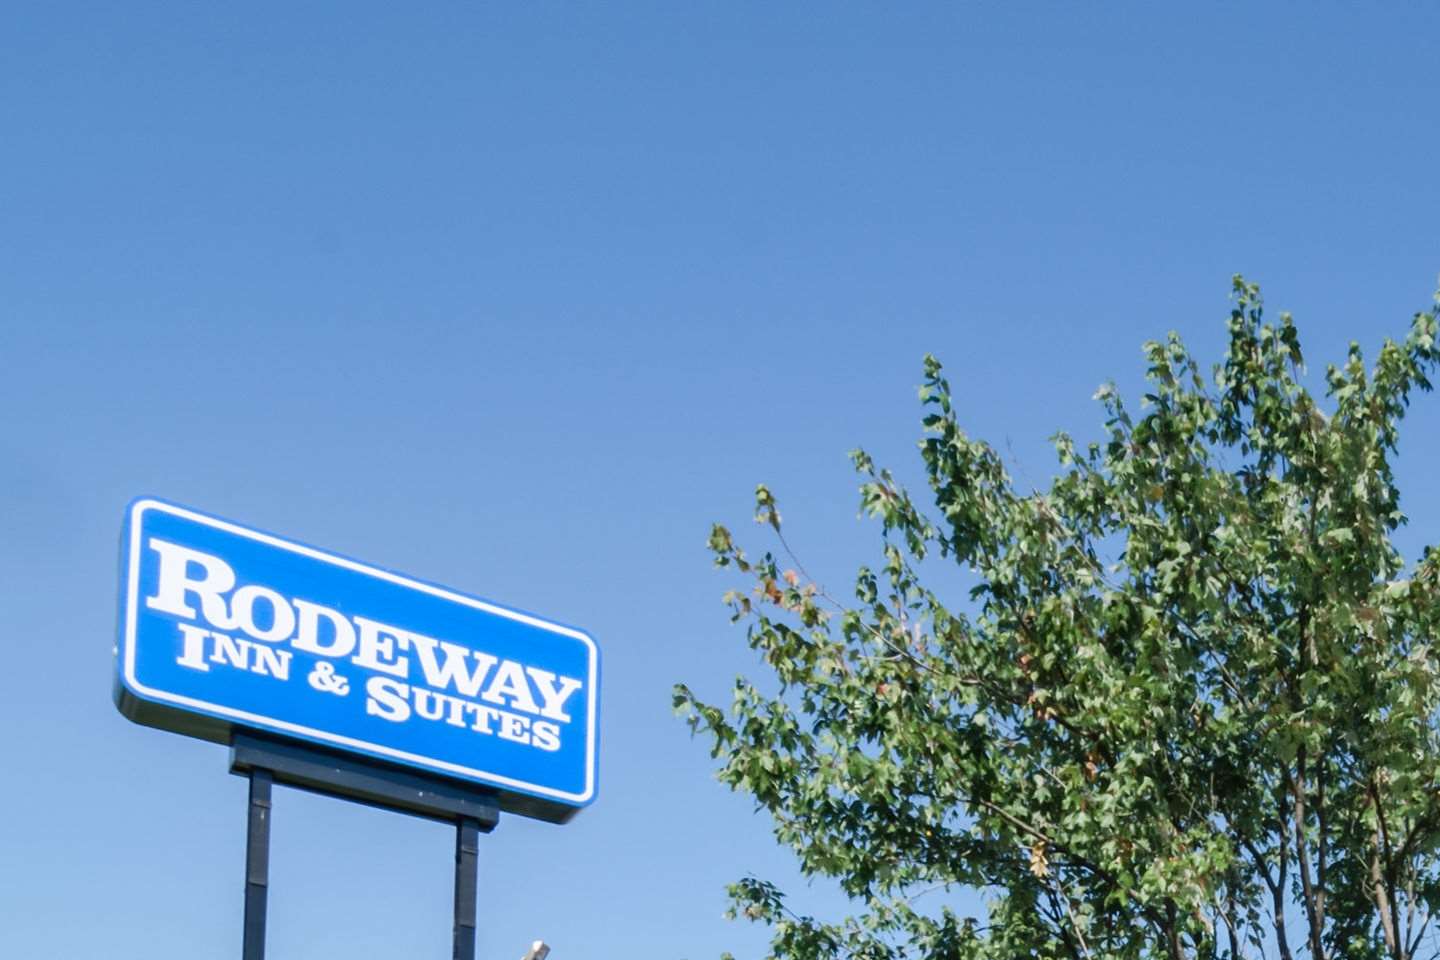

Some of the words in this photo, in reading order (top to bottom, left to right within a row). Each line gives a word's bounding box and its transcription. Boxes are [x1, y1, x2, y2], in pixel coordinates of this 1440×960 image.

[147, 538, 582, 723] RODEWAY
[176, 623, 293, 682] INN
[308, 661, 350, 696] &
[366, 676, 561, 752] SUITES
